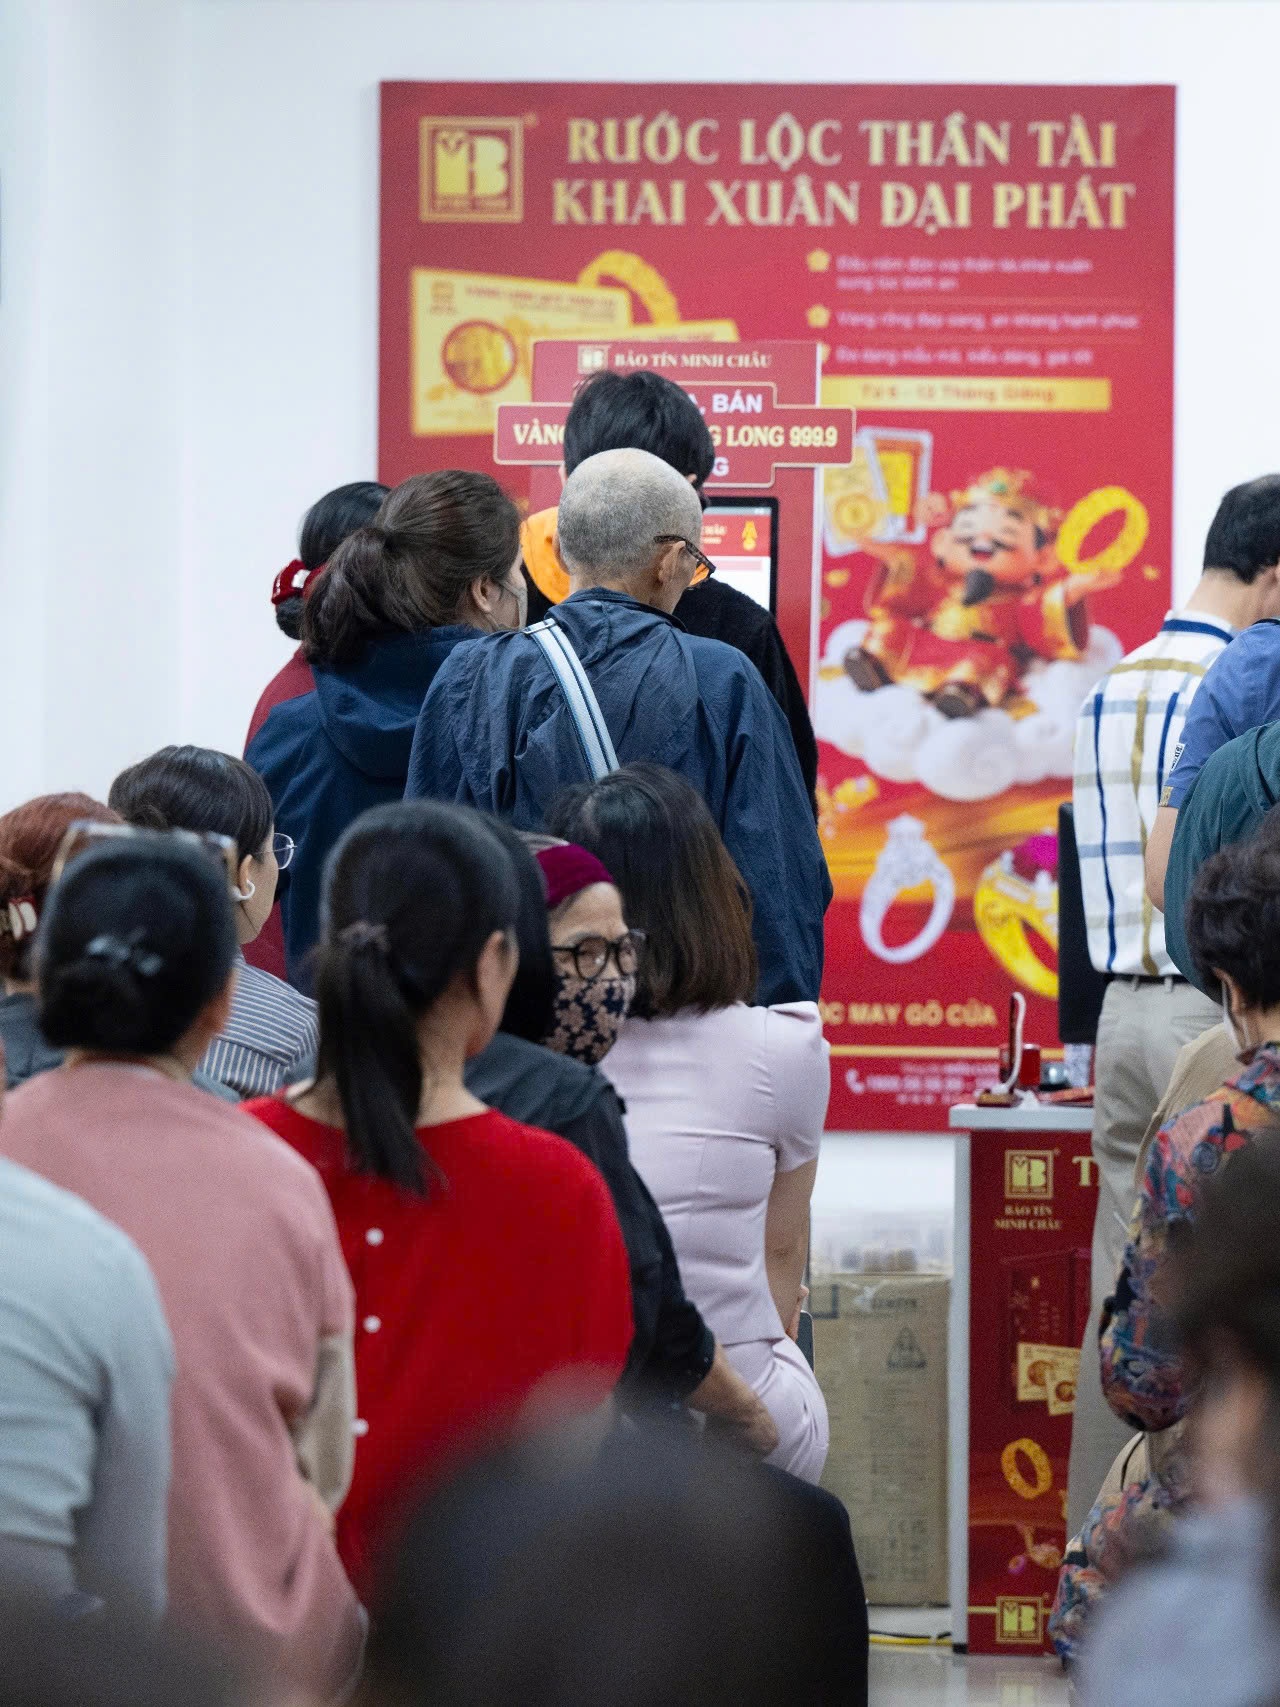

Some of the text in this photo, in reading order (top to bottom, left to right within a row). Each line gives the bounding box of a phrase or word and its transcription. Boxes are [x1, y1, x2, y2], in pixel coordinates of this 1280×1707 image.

[567, 111, 720, 165] RƯỚC
[739, 111, 843, 172] LỘC
[1026, 113, 1118, 168] TÀI
[552, 173, 1137, 236] KHAI XUÂN ĐẠI PHÁT
[681, 352, 724, 367] MINH
[712, 389, 763, 413] BÁN
[513, 418, 566, 445] VÀN
[726, 425, 785, 447] LONG
[789, 425, 838, 448] 999.9
